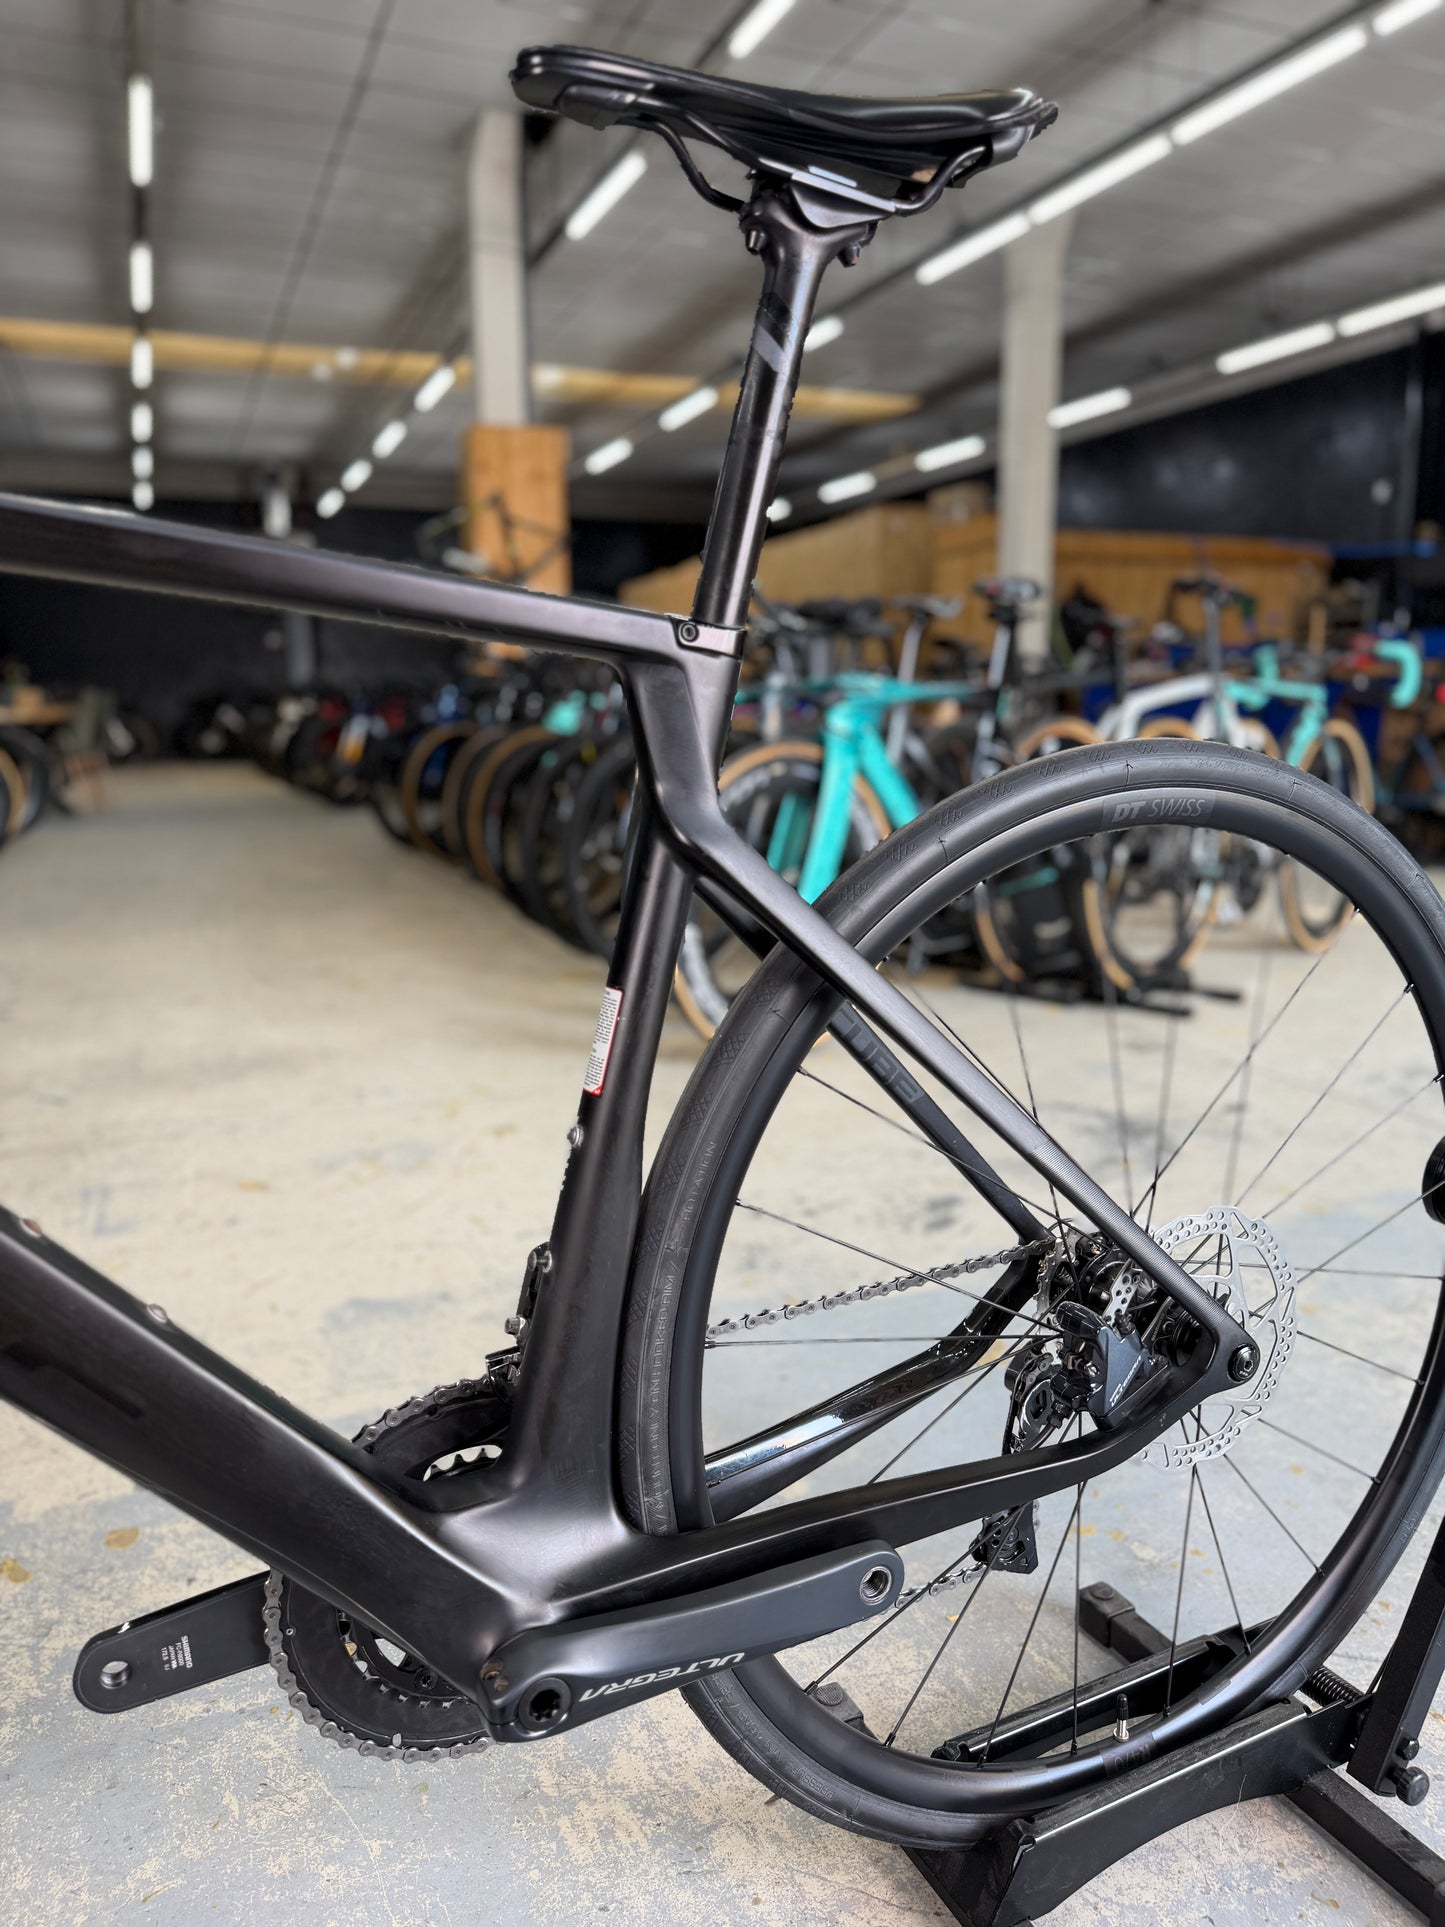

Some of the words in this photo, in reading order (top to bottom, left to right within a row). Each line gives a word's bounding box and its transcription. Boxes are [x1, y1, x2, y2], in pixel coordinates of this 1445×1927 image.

[1111, 800, 1146, 823] DT
[1148, 798, 1206, 818] SWISS
[681, 1141, 718, 1223] ROTATION
[662, 1274, 676, 1305] RIM
[181, 1635, 193, 1669] SHIMANO
[578, 1652, 746, 1703] ULTEGRA
